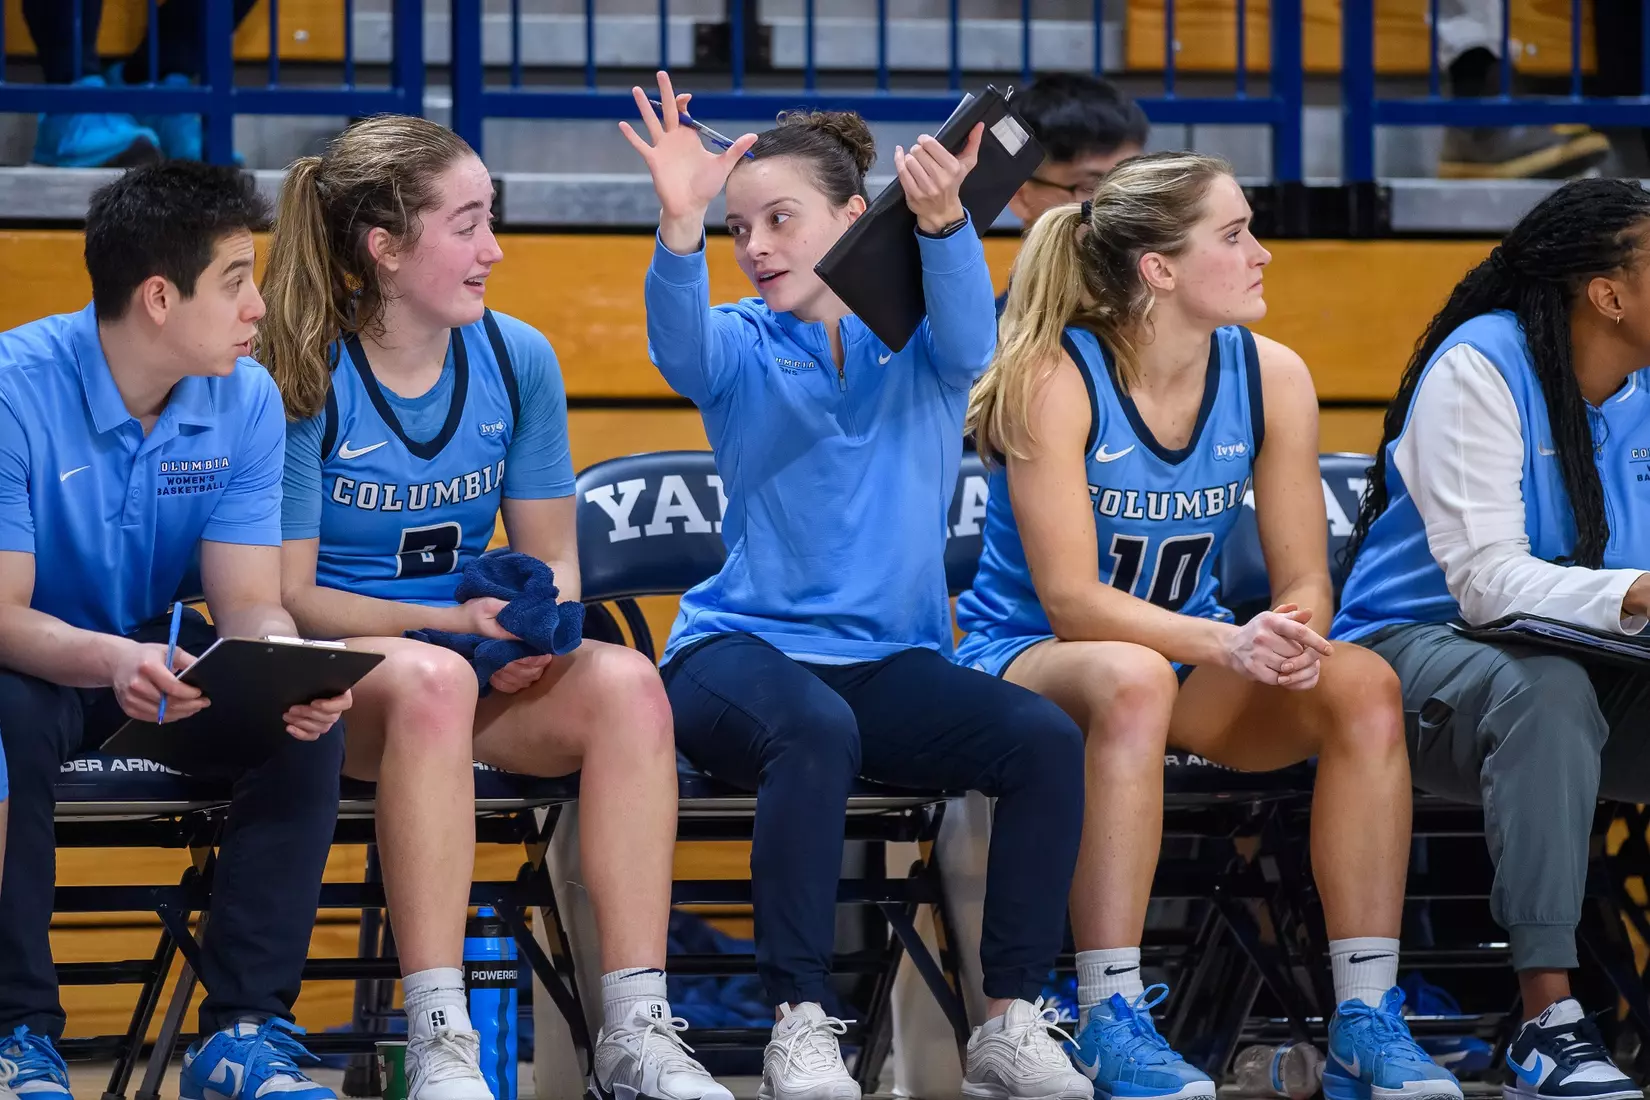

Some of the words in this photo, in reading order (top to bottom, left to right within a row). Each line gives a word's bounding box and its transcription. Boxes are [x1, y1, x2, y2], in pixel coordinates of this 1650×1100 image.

[159, 457, 229, 472] OLUMBIA
[167, 475, 215, 486] WOMEN'S
[1109, 532, 1215, 613] 10
[60, 758, 103, 773] DER
[110, 758, 192, 777] ARM
